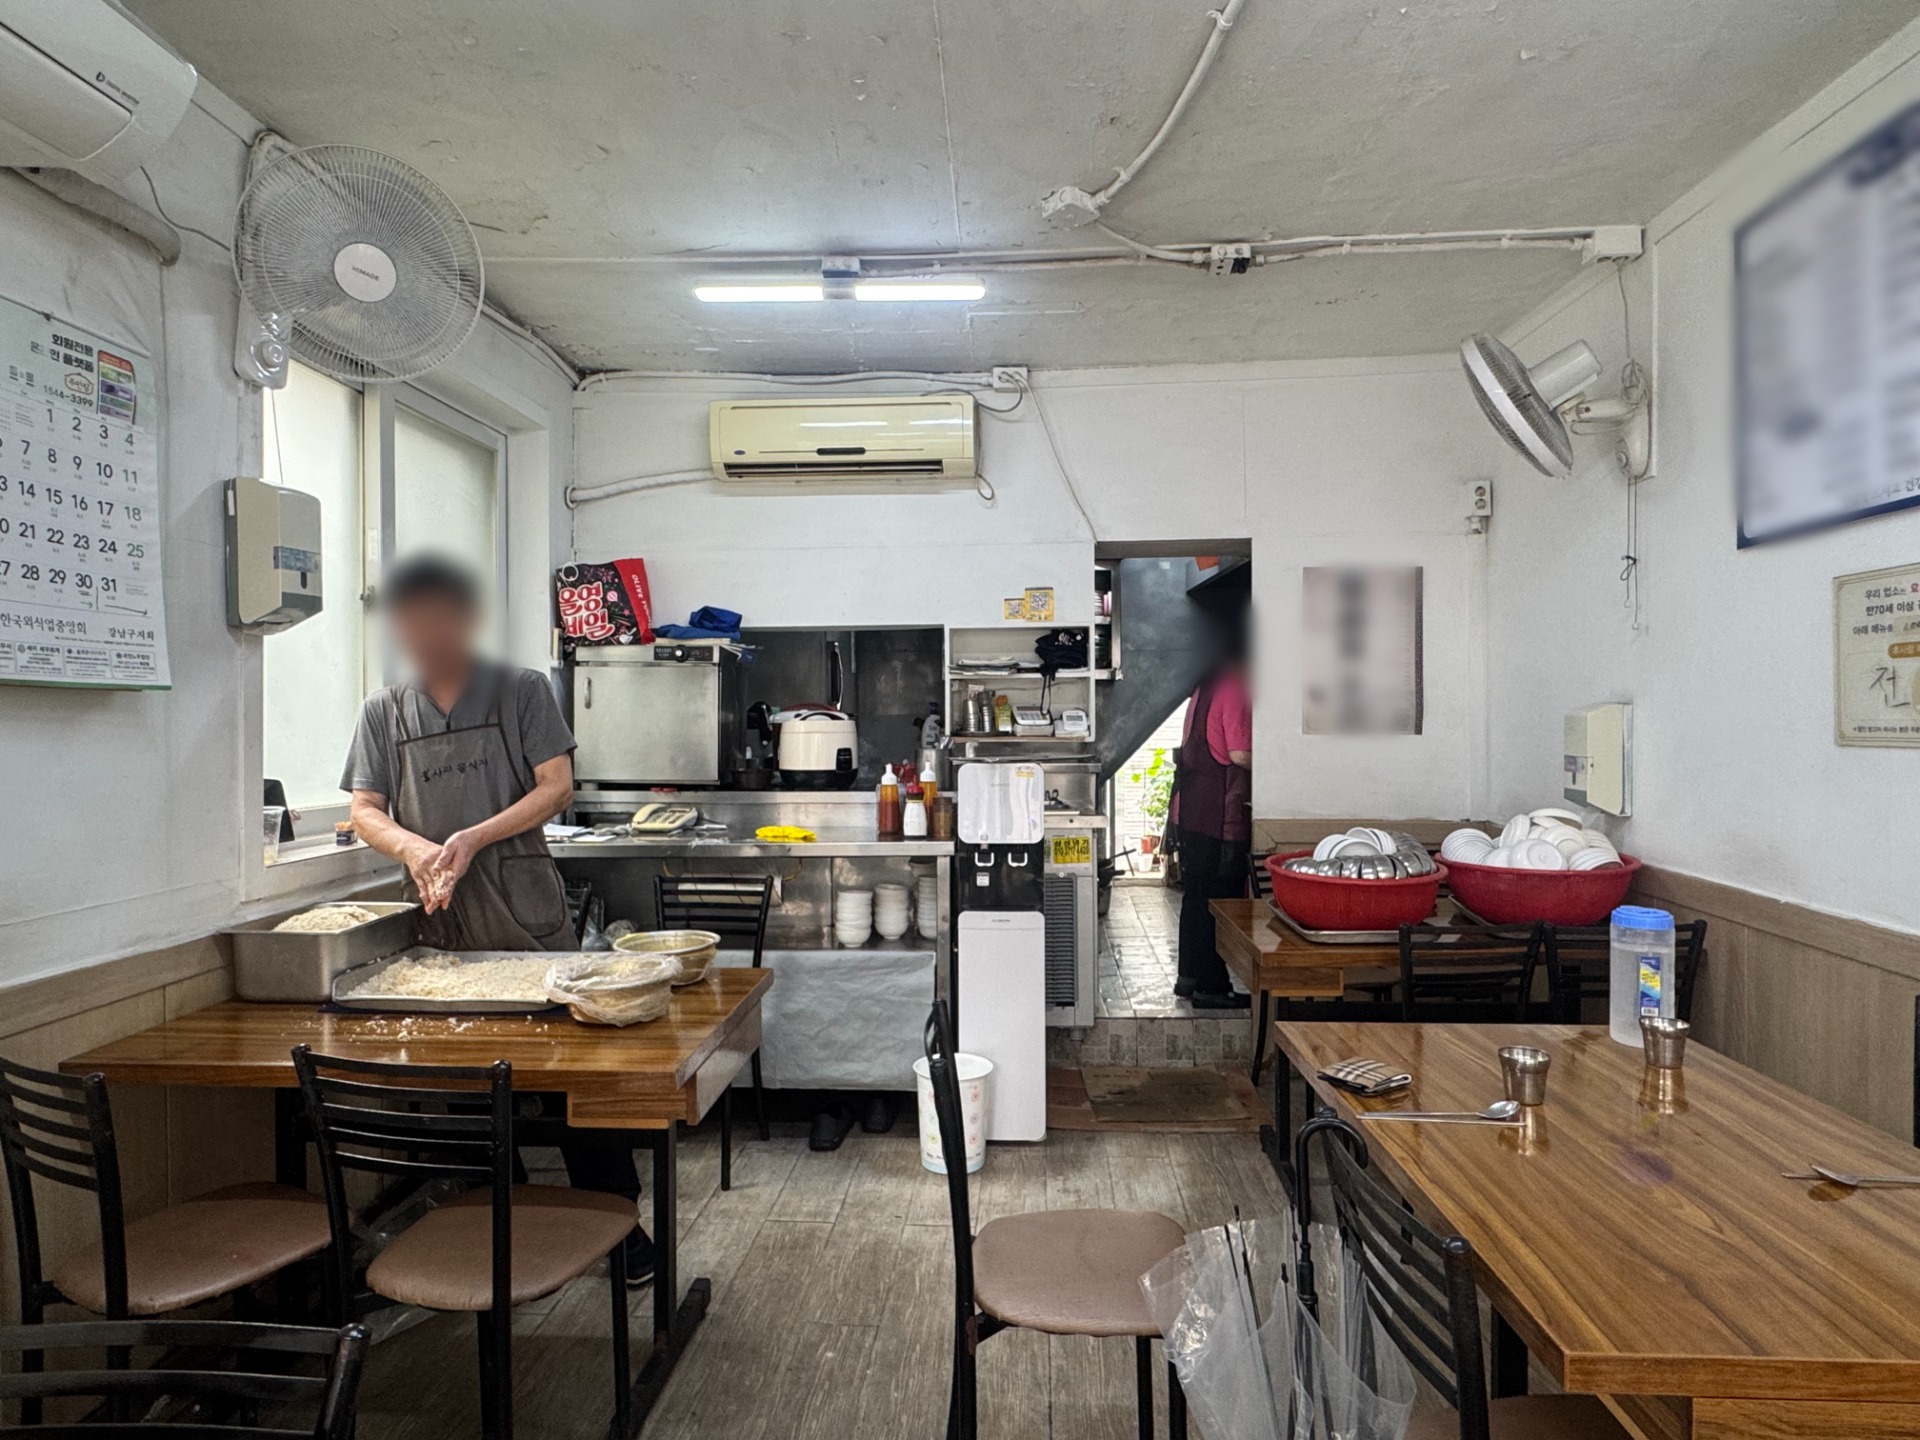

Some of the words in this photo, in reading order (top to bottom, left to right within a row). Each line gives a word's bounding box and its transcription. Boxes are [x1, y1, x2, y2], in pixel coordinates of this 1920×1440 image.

[30, 341, 60, 362] 온인
[63, 353, 94, 373] 플랫폼
[52, 333, 94, 357] 회원전용
[43, 385, 94, 408] 1544-3399
[47, 409, 53, 424] 1
[72, 417, 82, 432] 2
[99, 425, 109, 440] 3
[125, 433, 135, 447] 4
[21, 439, 30, 455] 7
[48, 448, 57, 464] 8
[73, 456, 82, 470] 9
[96, 462, 113, 479] 10
[122, 468, 138, 485] 11
[18, 481, 36, 498] 14
[45, 488, 63, 505] 15
[72, 494, 88, 511] 16
[97, 501, 114, 516] 17
[124, 506, 142, 522] 18
[19, 522, 36, 539] 21
[47, 528, 65, 545] 22
[73, 533, 90, 550] 23
[98, 538, 118, 554] 24
[127, 543, 144, 558] 25
[21, 564, 40, 581] 28
[48, 568, 66, 585] 29
[75, 573, 93, 589] 30
[101, 577, 118, 592] 31
[632, 574, 643, 599] OLIVE
[559, 581, 603, 617] 올영
[1865, 589, 1881, 600] 우리
[1866, 603, 1894, 616] 만70세
[1897, 601, 1914, 612] 이상
[0, 612, 87, 635] 한국외식업중앙회
[108, 627, 154, 641] 강남구지회
